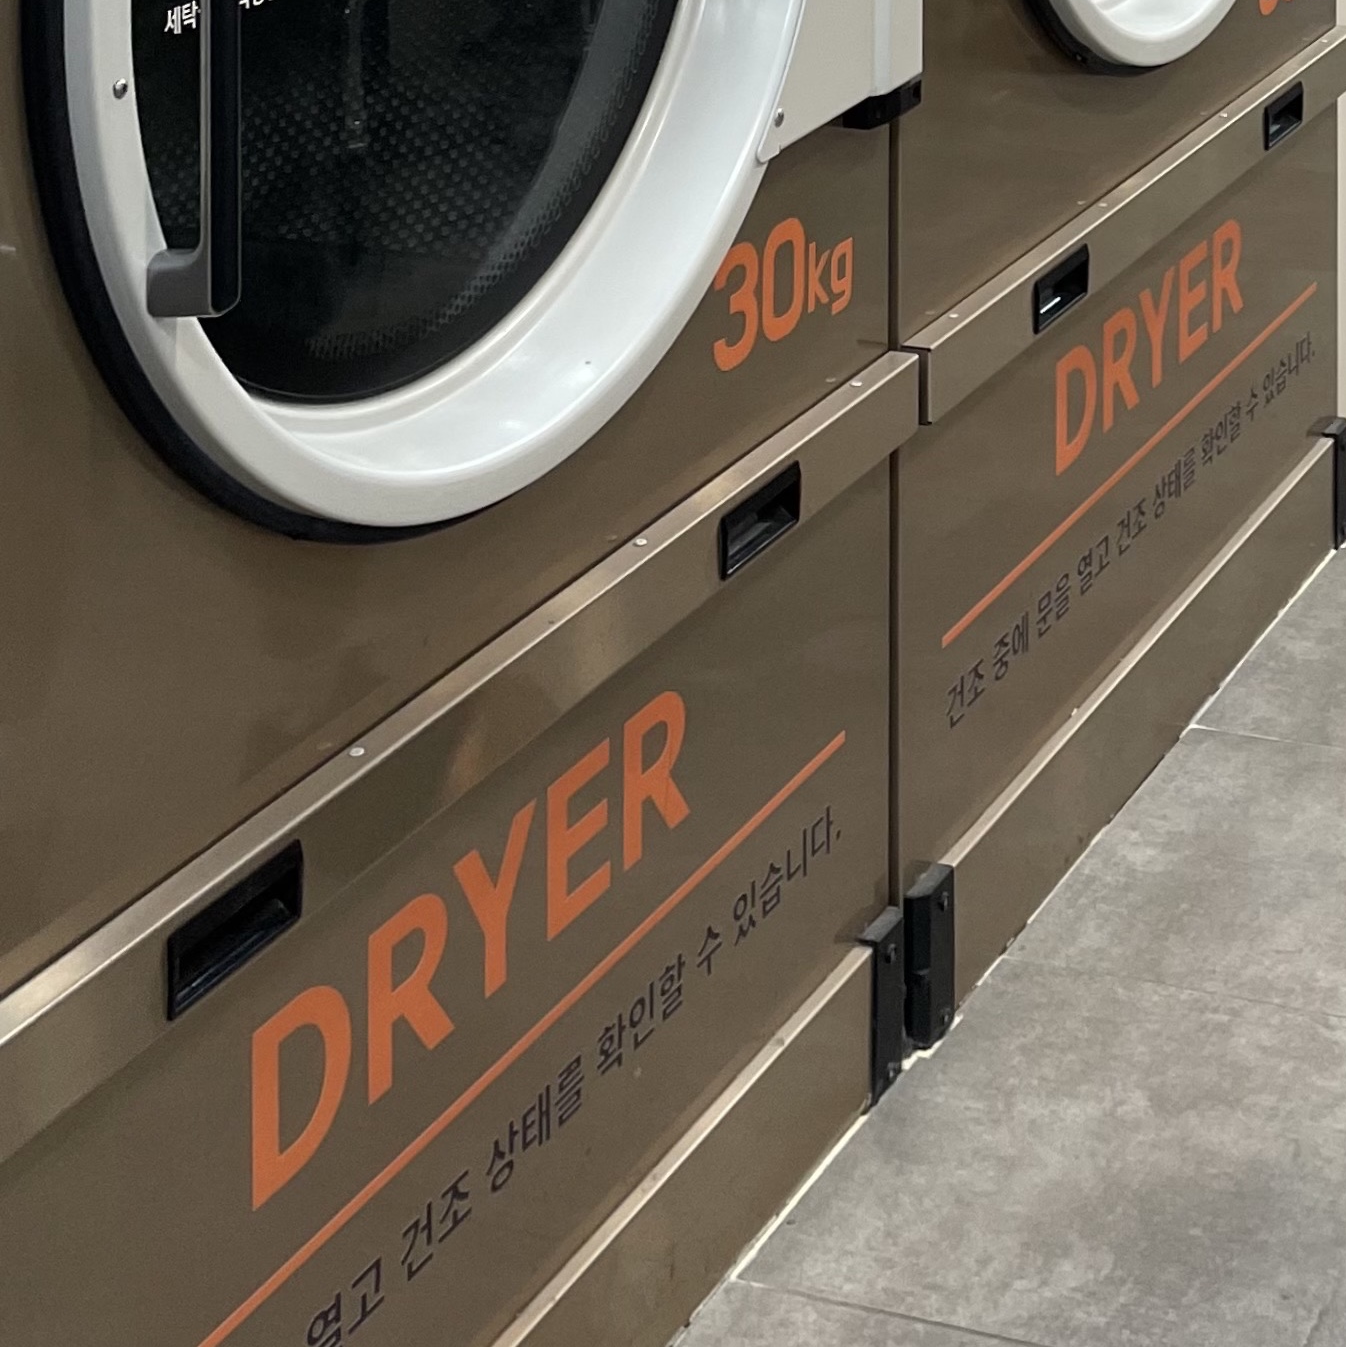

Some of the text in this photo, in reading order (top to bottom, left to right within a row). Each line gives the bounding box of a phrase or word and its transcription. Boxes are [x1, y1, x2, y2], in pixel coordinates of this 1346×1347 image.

[713, 217, 853, 372] 30kg
[1056, 218, 1244, 476] DRYER
[945, 332, 1316, 729] 건조 중에 문을 열고 건조 상태를 확인할 수 있습니다.
[252, 689, 691, 1213] DRYER
[400, 1169, 473, 1282] 건조
[486, 1055, 585, 1194] 상태를
[596, 953, 686, 1077] 확인할
[696, 924, 722, 977] 수
[732, 805, 843, 947] 있습니다.
